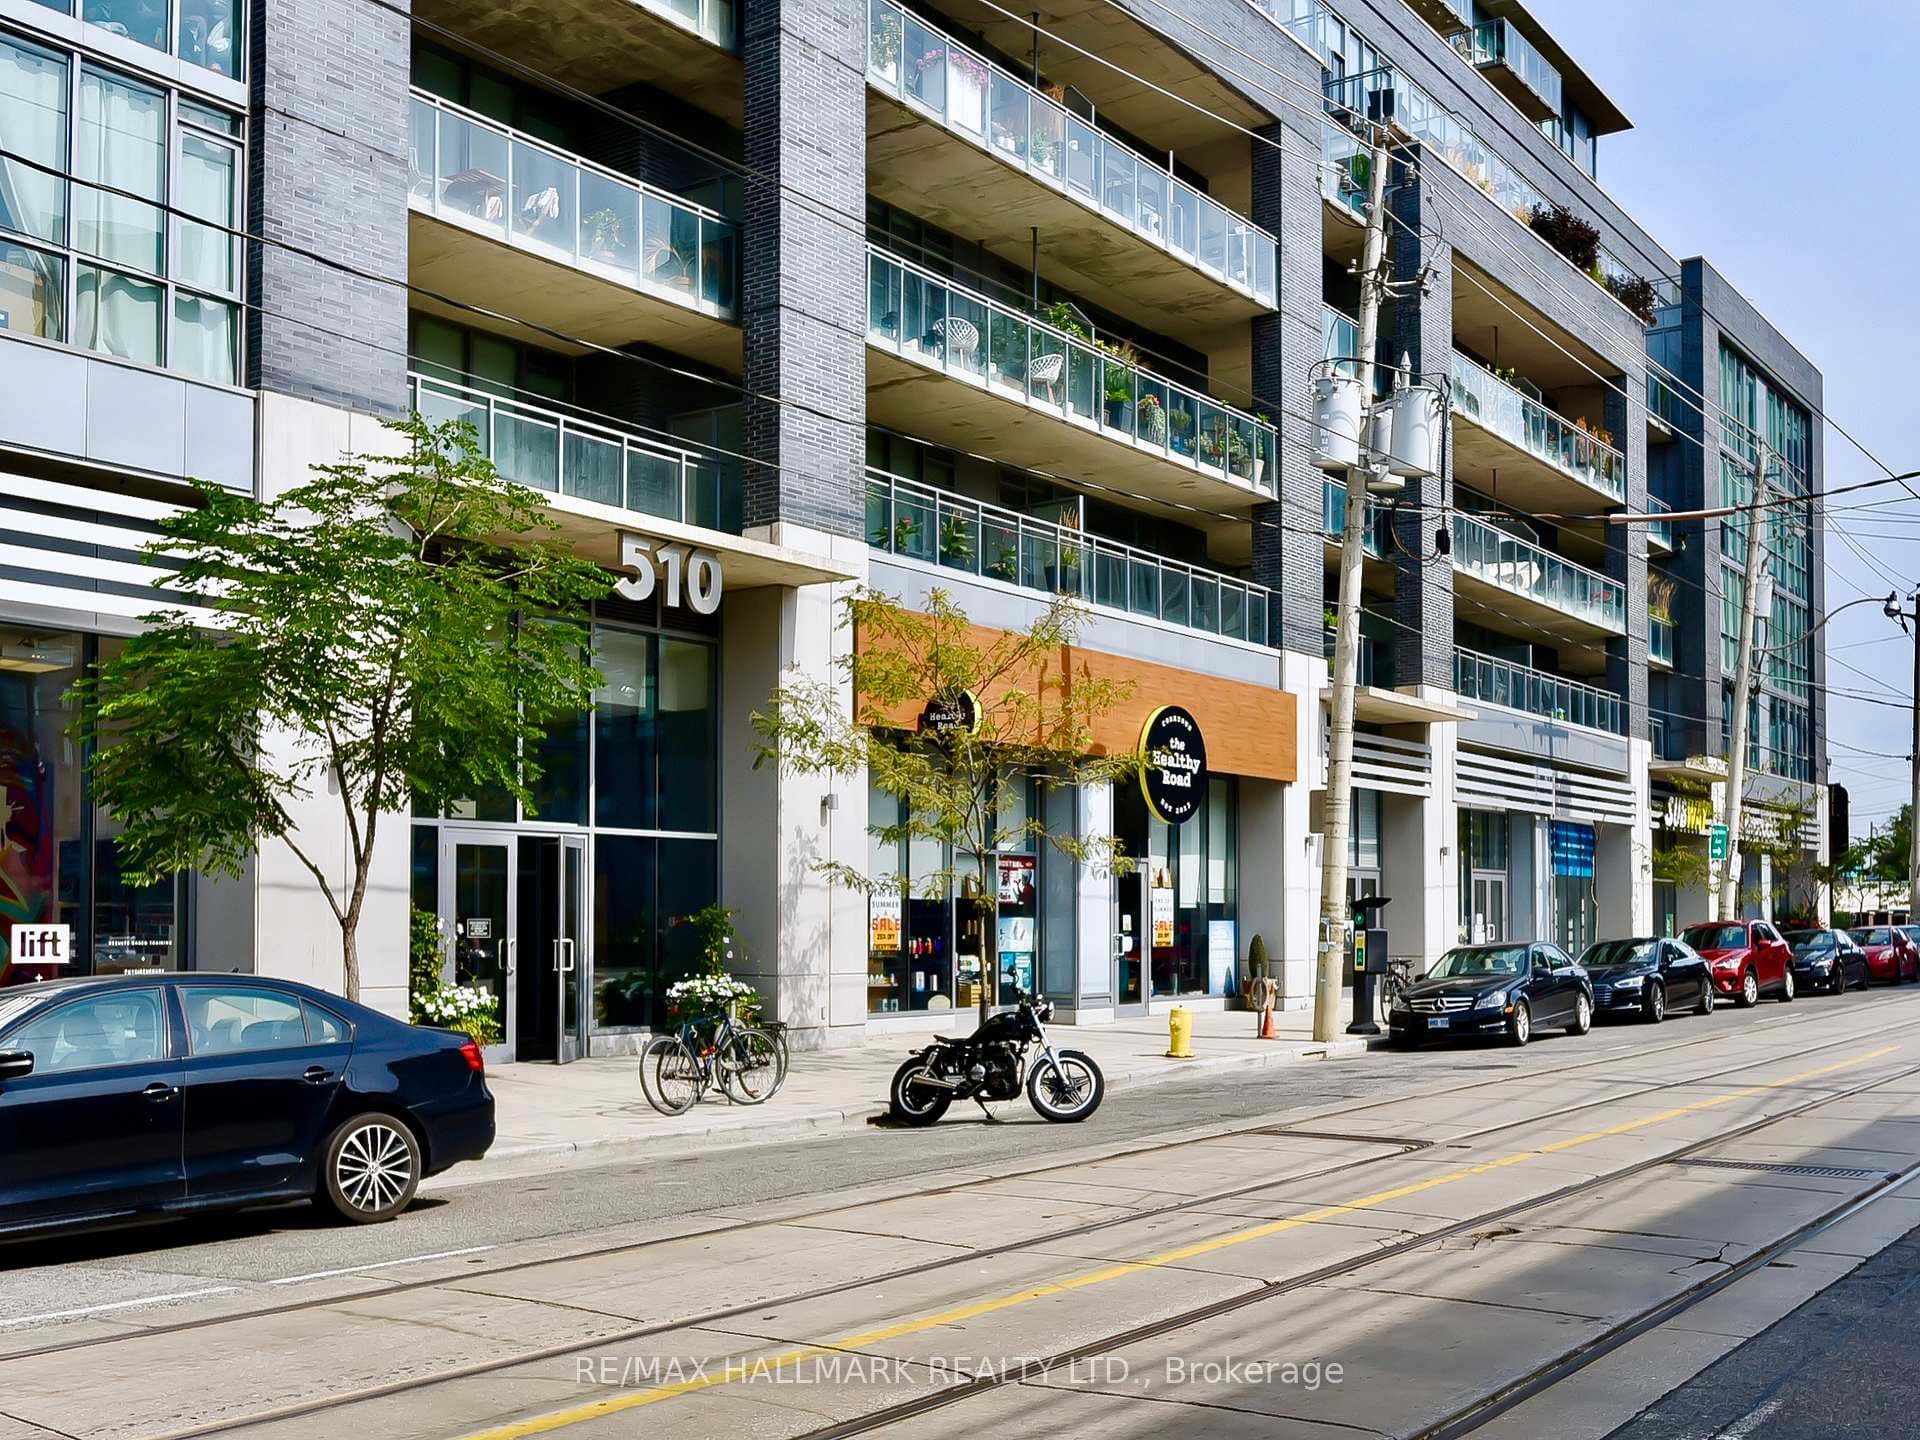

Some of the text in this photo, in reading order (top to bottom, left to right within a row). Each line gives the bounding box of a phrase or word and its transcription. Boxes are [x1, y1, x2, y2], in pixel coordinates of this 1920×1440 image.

[615, 532, 722, 615] 510
[1169, 737, 1186, 750] the
[1152, 750, 1201, 774] Healthy
[1162, 770, 1191, 787] Road
[1664, 796, 1711, 831] SUBWAY
[872, 918, 901, 931] SALE
[20, 931, 61, 957] lift
